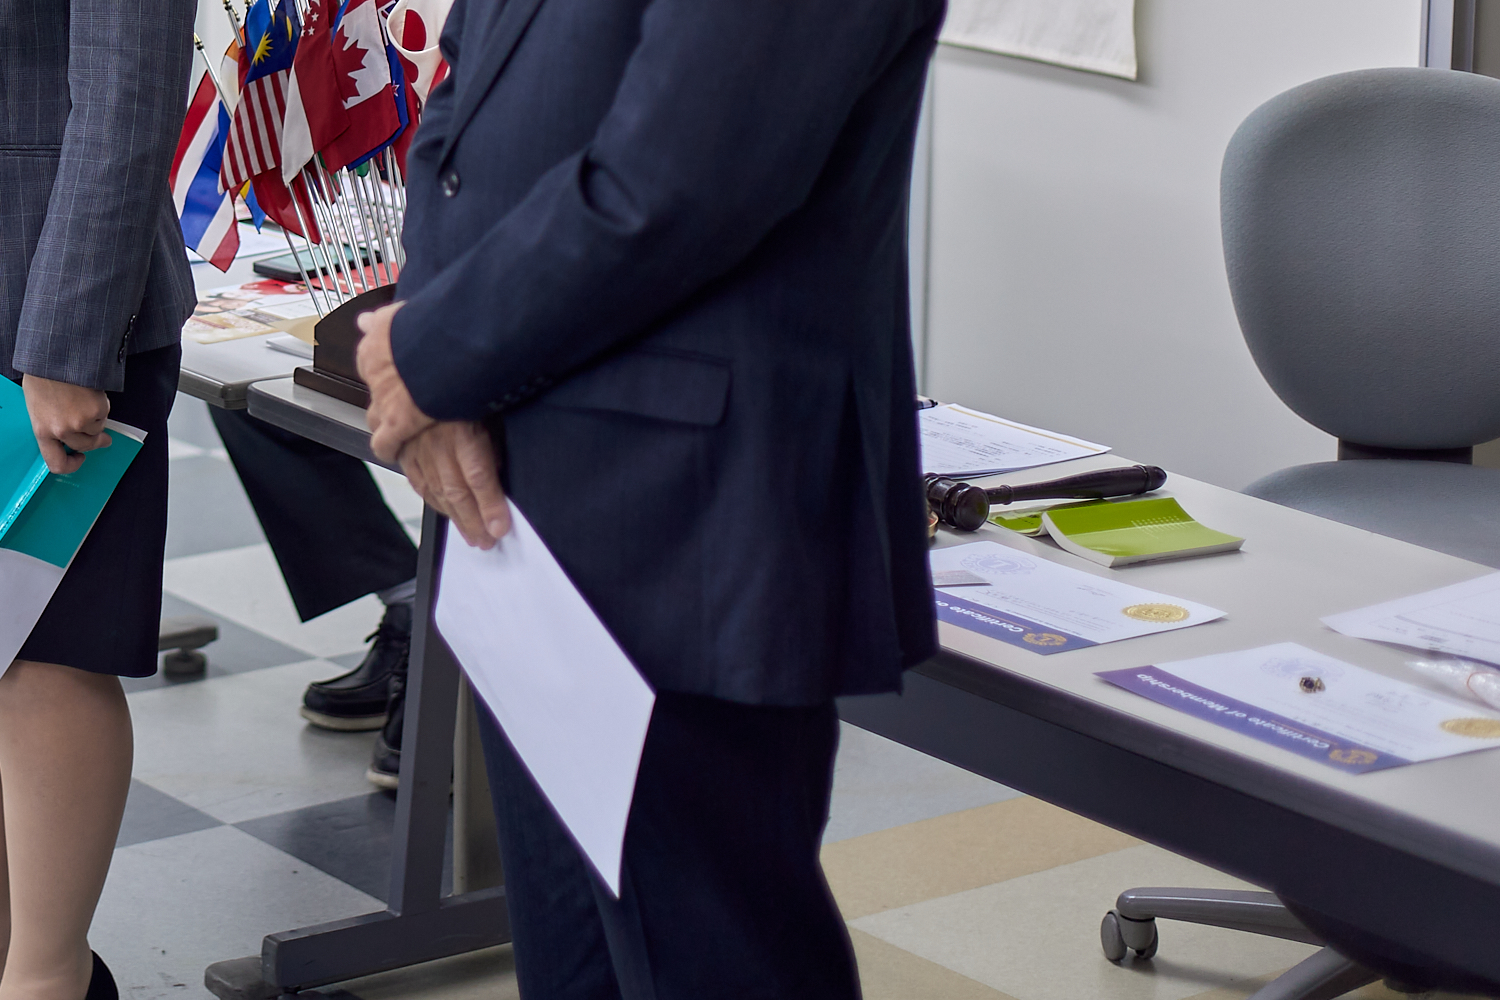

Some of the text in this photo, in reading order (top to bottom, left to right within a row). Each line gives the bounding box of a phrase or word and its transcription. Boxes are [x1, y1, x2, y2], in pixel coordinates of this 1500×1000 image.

[949, 605, 1024, 633] Certificate
[1136, 673, 1229, 712] Membership
[1227, 710, 1247, 718] of
[1248, 717, 1330, 748] Certificate
